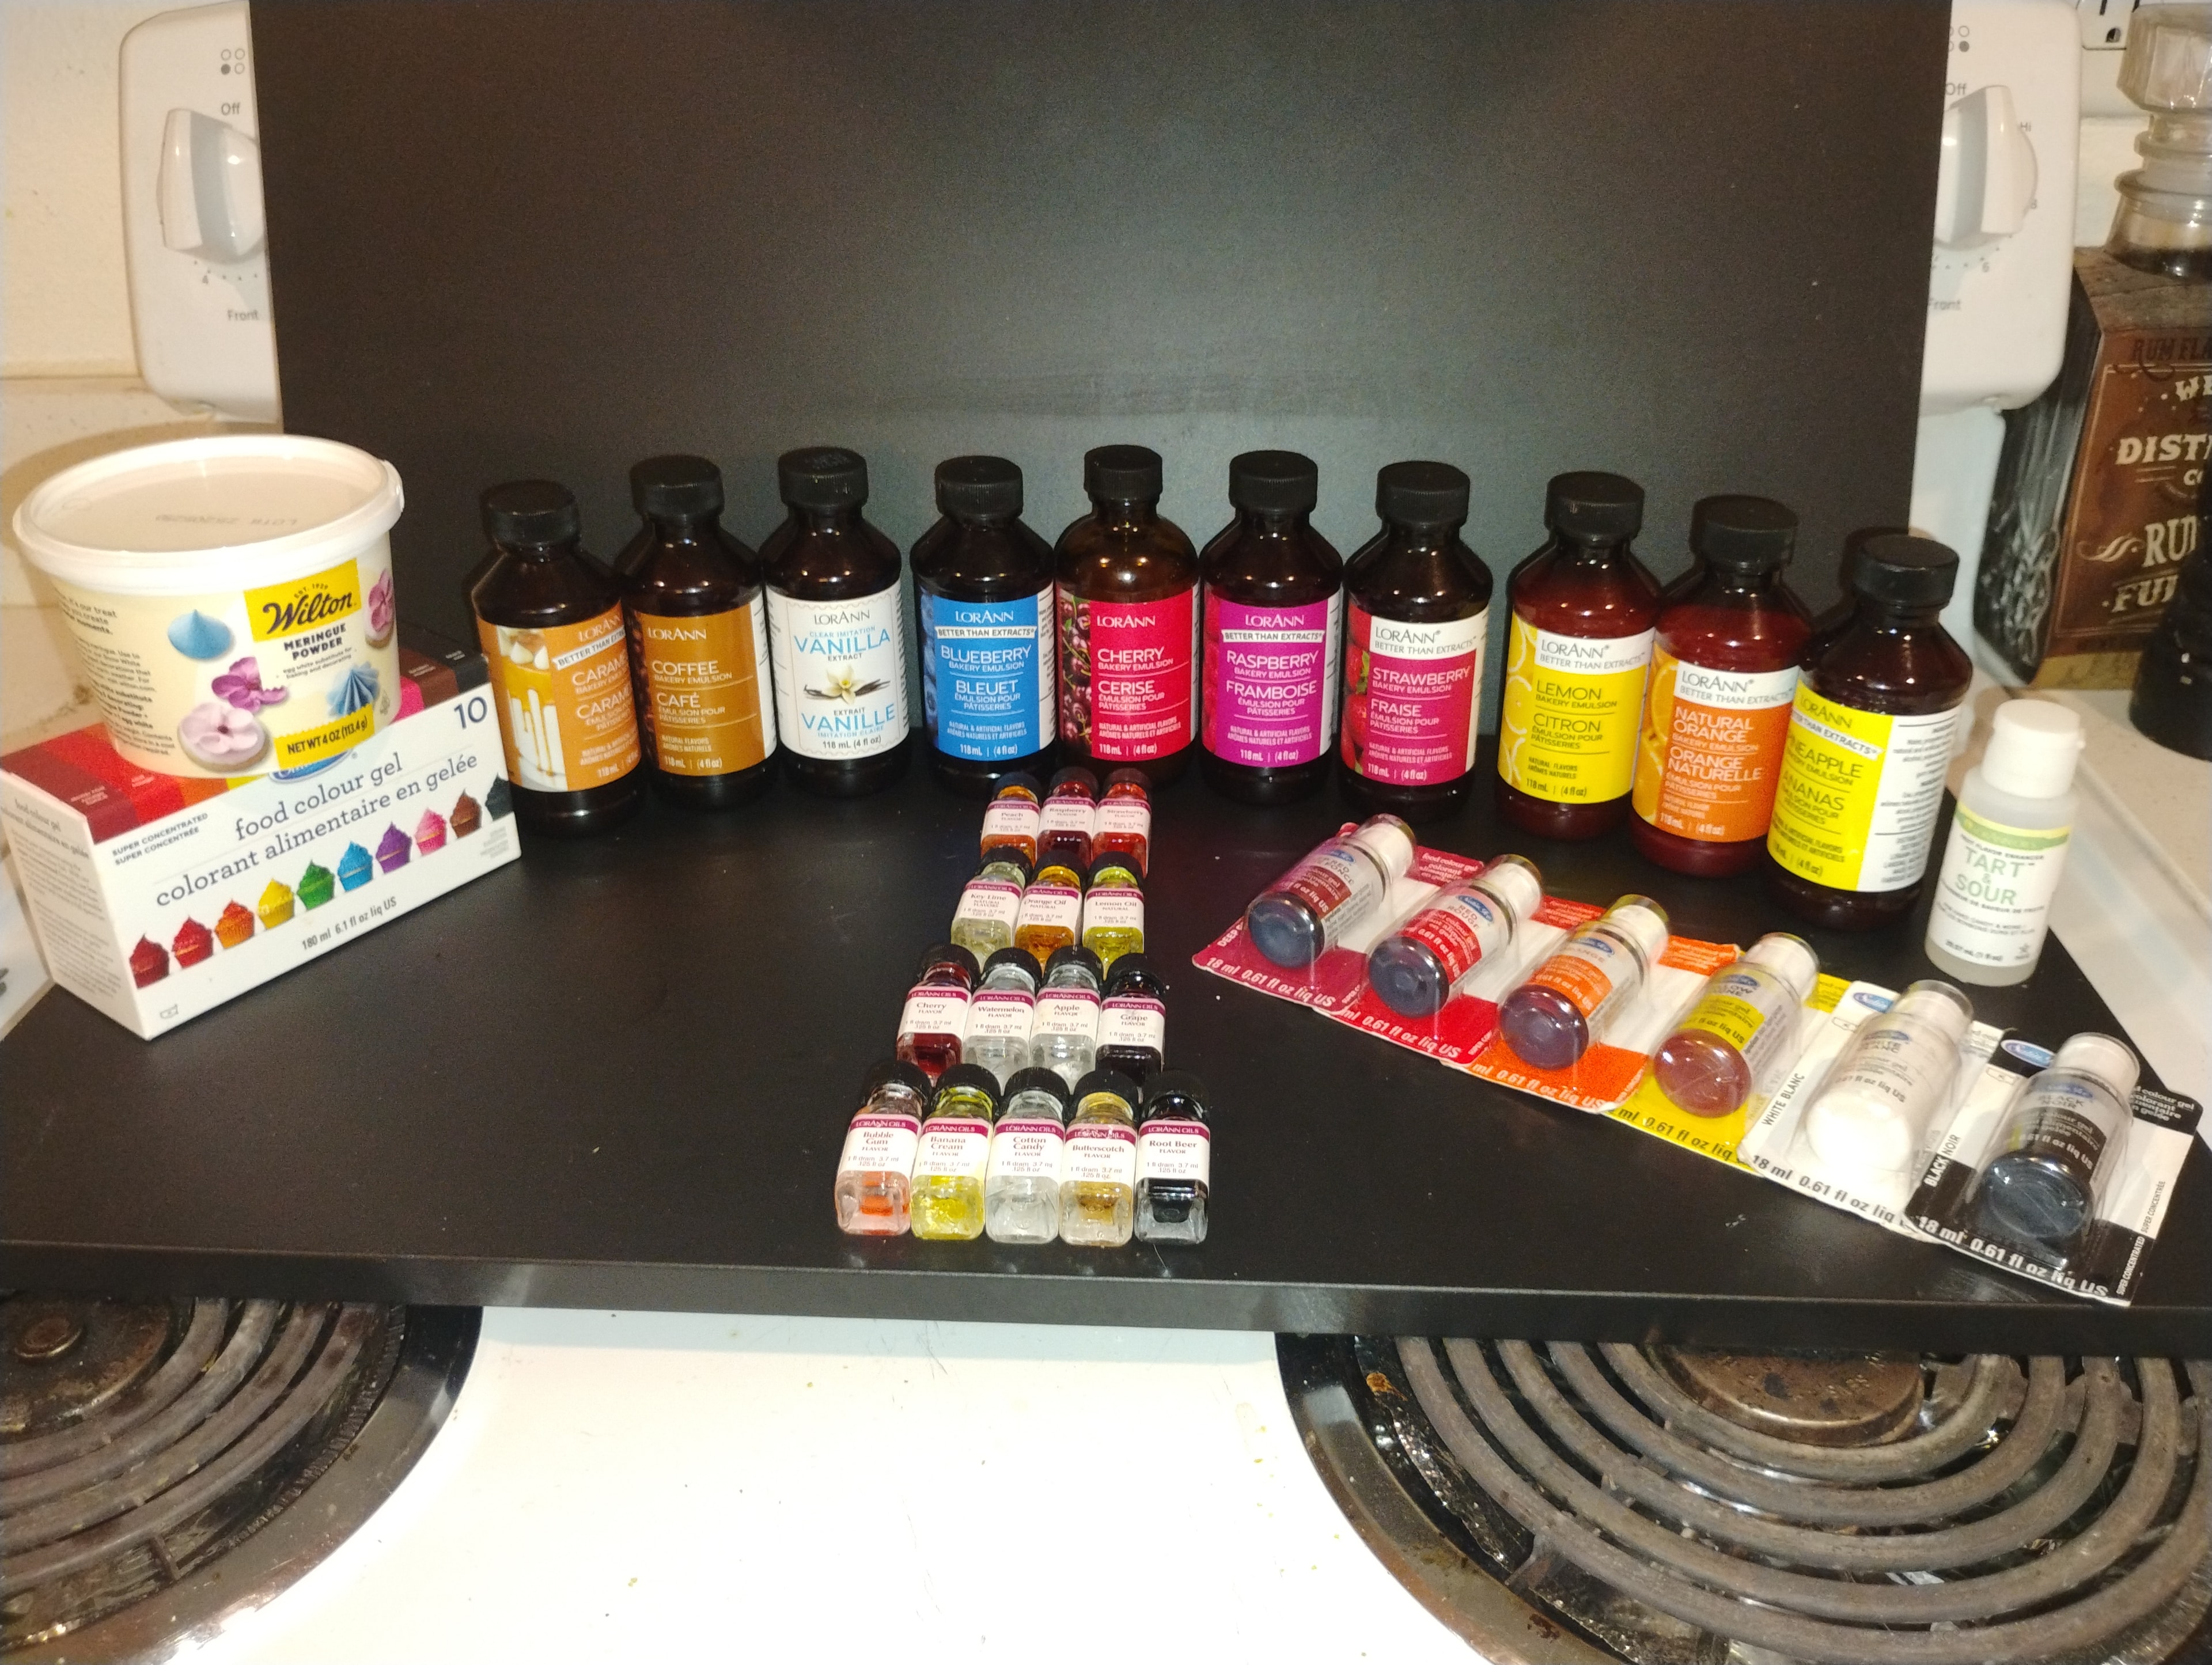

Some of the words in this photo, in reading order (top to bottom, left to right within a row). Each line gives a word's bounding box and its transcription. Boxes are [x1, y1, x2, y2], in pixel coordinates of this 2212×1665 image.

[1945, 82, 1967, 96] Off
[221, 102, 241, 115] Off
[228, 308, 259, 323] Front
[2132, 336, 2176, 361] RUM
[2115, 432, 2212, 466] DIST
[263, 591, 353, 635] Wilton
[283, 623, 347, 652] MERINGUE
[794, 628, 891, 656] VANILLA
[809, 630, 835, 639] CLEAR
[836, 625, 876, 638] IMITATION
[938, 628, 965, 637] BETTER
[967, 628, 990, 637] THAN
[1225, 632, 1253, 640] BETTER
[1256, 632, 1279, 640] THAN
[292, 635, 343, 661] POWDER
[558, 647, 592, 667] BETTER
[828, 653, 863, 662] EXTRACT
[941, 644, 1032, 665] BLUEBERRY
[1097, 646, 1165, 663] CHERRY
[1374, 640, 1406, 655] BETTER
[1407, 646, 1434, 655] THAN
[297, 661, 315, 672] white
[315, 651, 345, 665] substitute
[652, 659, 719, 677] COFFEE
[949, 661, 980, 673] BAKERY
[982, 661, 1025, 673] EMULSION
[1097, 662, 1131, 672] BAKERY
[1132, 658, 1174, 672] EMULSION
[1226, 649, 1319, 670] RASPBERRY
[1540, 654, 1571, 668] BETTER
[1574, 660, 1601, 670] THAN
[286, 669, 309, 680] baking
[687, 672, 733, 685] EMULSION
[1234, 667, 1267, 678] BAKERY
[1268, 667, 1311, 679] EMULSION
[1373, 665, 1469, 686] STRAWBERRY
[956, 679, 1019, 696] BLEUET
[997, 693, 1021, 702] POUR
[1097, 680, 1156, 696] CERISE
[1142, 692, 1165, 702] POUR
[1226, 680, 1318, 700] FRAMBOISE
[1372, 680, 1406, 693] BAKERY
[1407, 684, 1452, 695] EMULSION
[1536, 679, 1602, 701] LEMON
[1680, 685, 1712, 700] BETTER
[1716, 694, 1745, 704] THAN
[656, 692, 701, 708] CAFÉ
[1282, 697, 1305, 708] POUR
[1370, 698, 1422, 717] FRAISE
[1535, 693, 1570, 707] BAKERY
[1571, 700, 1617, 708] EMULSION
[453, 696, 488, 730] 10
[801, 703, 896, 733] VANILLE
[834, 707, 866, 717] EXTRAIT
[1415, 717, 1440, 726] POUR
[1675, 706, 1754, 731] NATURAL
[1533, 712, 1601, 733] CITRON
[1673, 719, 1747, 743] ORANGE
[287, 739, 307, 755] NET
[307, 734, 321, 751] WT
[817, 730, 858, 739] IMITATION
[1670, 745, 1744, 769] ORANGE
[1668, 757, 1763, 782] NATURELLE
[234, 801, 291, 843] food
[293, 775, 365, 817] colour
[369, 752, 404, 788] gel
[111, 838, 140, 857] SUPER
[142, 811, 209, 847] CONCENTRATED
[155, 852, 260, 909] colorant
[264, 792, 392, 858] alimentaire
[396, 778, 425, 802] en
[425, 753, 479, 790] gelée
[115, 847, 144, 867] SUPER
[143, 826, 200, 857] CONCENTRÉE
[1965, 845, 2024, 878] TART
[1955, 874, 2017, 906] SOUR
[1446, 904, 1480, 930] ROUGE
[302, 933, 319, 952] 180
[1221, 964, 1240, 976] ml
[1240, 968, 1268, 985] 0.61
[1294, 985, 1310, 1003] liq
[1314, 992, 1337, 1008] US
[916, 1002, 947, 1010] Cherry
[1362, 1015, 1391, 1032] 0.61
[1417, 1036, 1438, 1053] liq
[1438, 1042, 1462, 1059] US
[1496, 1068, 1526, 1085] 0.61
[1761, 1099, 1784, 1126] WHITE
[1782, 1072, 1805, 1100] BLANC
[1013, 1136, 1047, 1144] Cotton
[1013, 1143, 1046, 1151] Candy
[1072, 1144, 1125, 1153] Butterscotch
[1644, 1116, 1674, 1133] 0.61
[1690, 1136, 1709, 1150] oz
[1711, 1143, 1734, 1161] liq
[1923, 1152, 1950, 1188] BLACK
[1940, 1133, 1962, 1158] NOIR
[1752, 1154, 1770, 1170] 18
[1770, 1165, 1794, 1181] ml
[1798, 1175, 1831, 1197] 0.61
[1850, 1198, 1870, 1211] oz
[1873, 1204, 1896, 1223] liq
[2147, 1179, 2166, 1216] CONCENTRÉE
[1919, 1216, 1938, 1233] 18
[1938, 1223, 1964, 1245] ml
[1969, 1238, 2005, 1261] 0.61
[2024, 1260, 2048, 1279] oz
[2050, 1266, 2077, 1292] liq
[2080, 1278, 2109, 1298] US
[2120, 1235, 2145, 1280] CONCENTRATED
